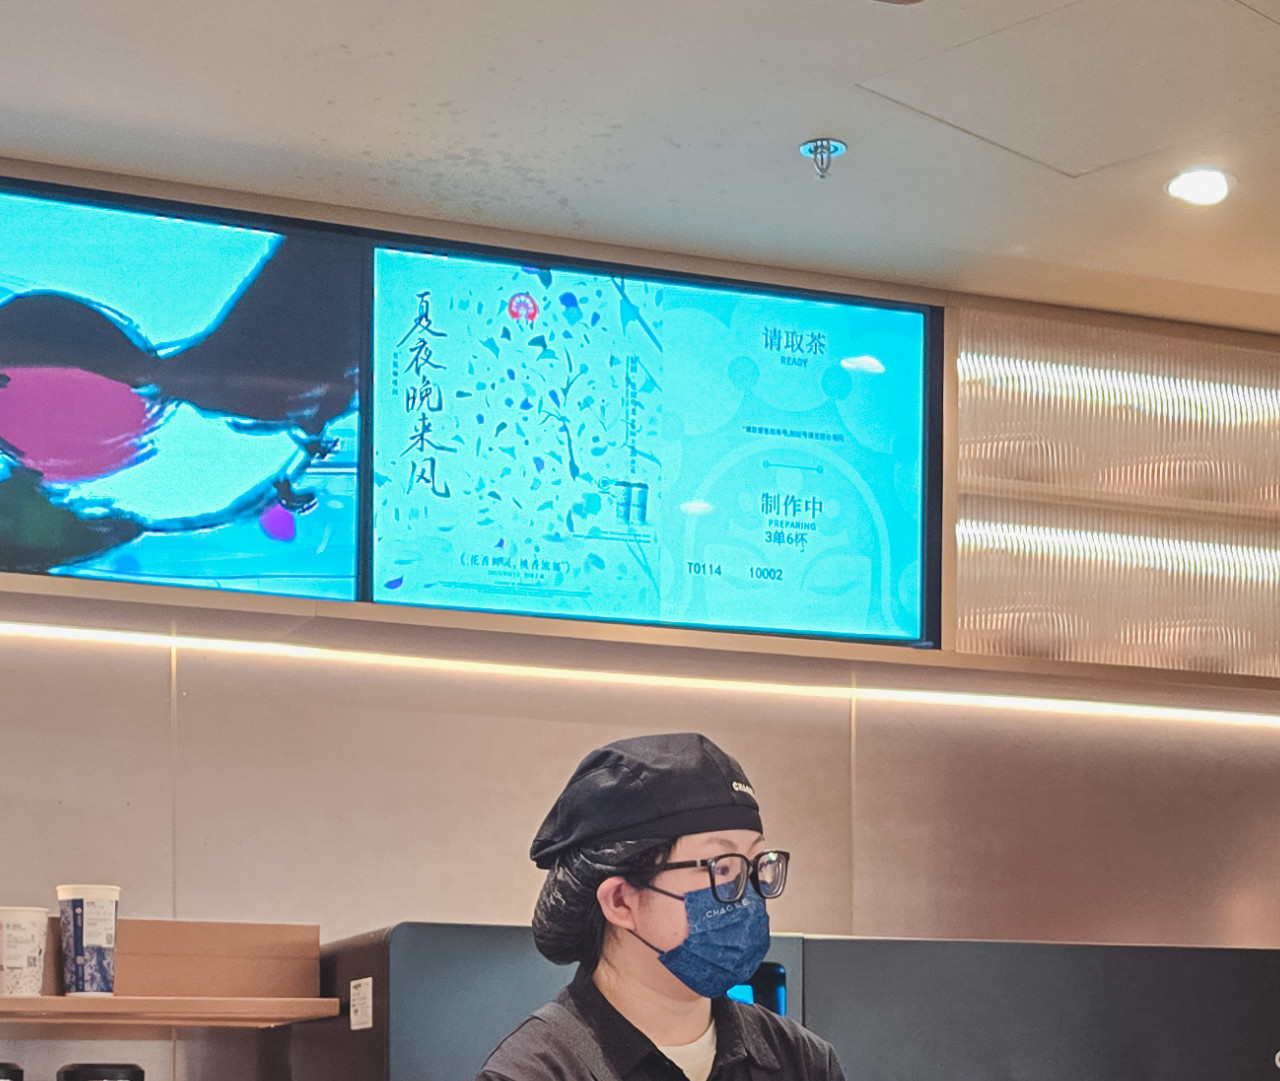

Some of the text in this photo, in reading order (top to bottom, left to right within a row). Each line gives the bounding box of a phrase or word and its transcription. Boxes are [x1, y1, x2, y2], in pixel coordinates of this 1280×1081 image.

[762, 326, 827, 356] 请取茶
[780, 355, 809, 367] READY
[397, 290, 457, 498] 夏夜晚来风
[761, 492, 824, 519] 制作中
[768, 519, 817, 531] PREPARING
[764, 531, 808, 547] 3单6杯
[686, 561, 784, 581] T0114 10002
